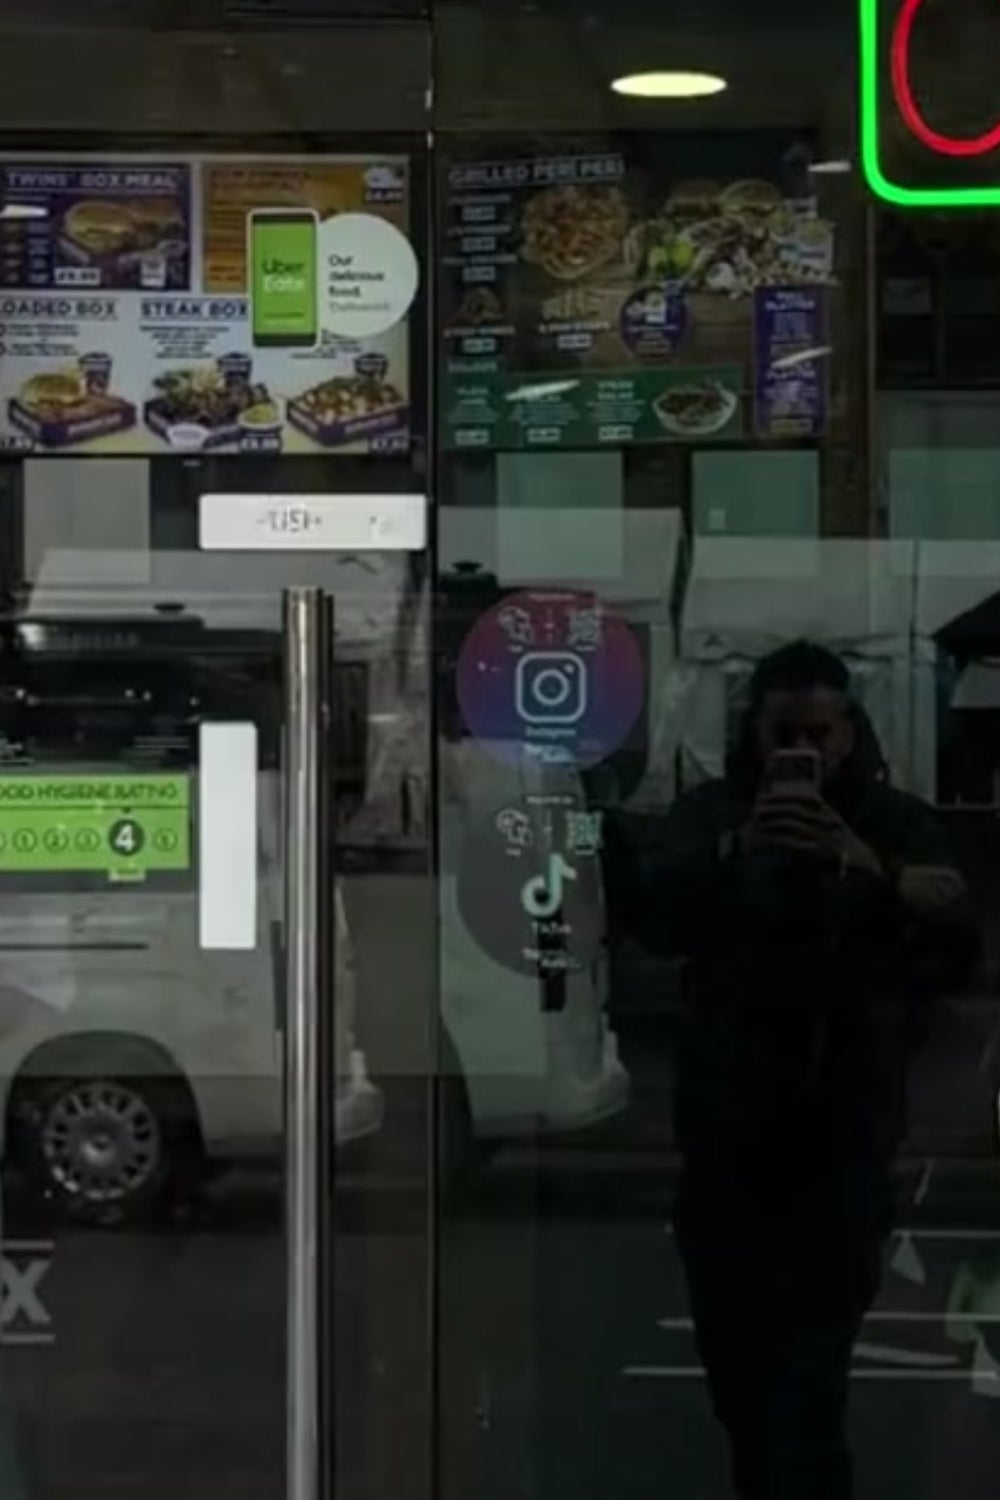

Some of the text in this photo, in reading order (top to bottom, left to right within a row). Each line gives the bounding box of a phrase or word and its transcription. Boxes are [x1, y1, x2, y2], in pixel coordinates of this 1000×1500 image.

[262, 258, 305, 276] Uber
[263, 276, 305, 293] Eats
[141, 302, 200, 317] STEAK
[37, 784, 110, 799] HYGIENE
[114, 784, 178, 799] RATING
[114, 824, 137, 852] 4
